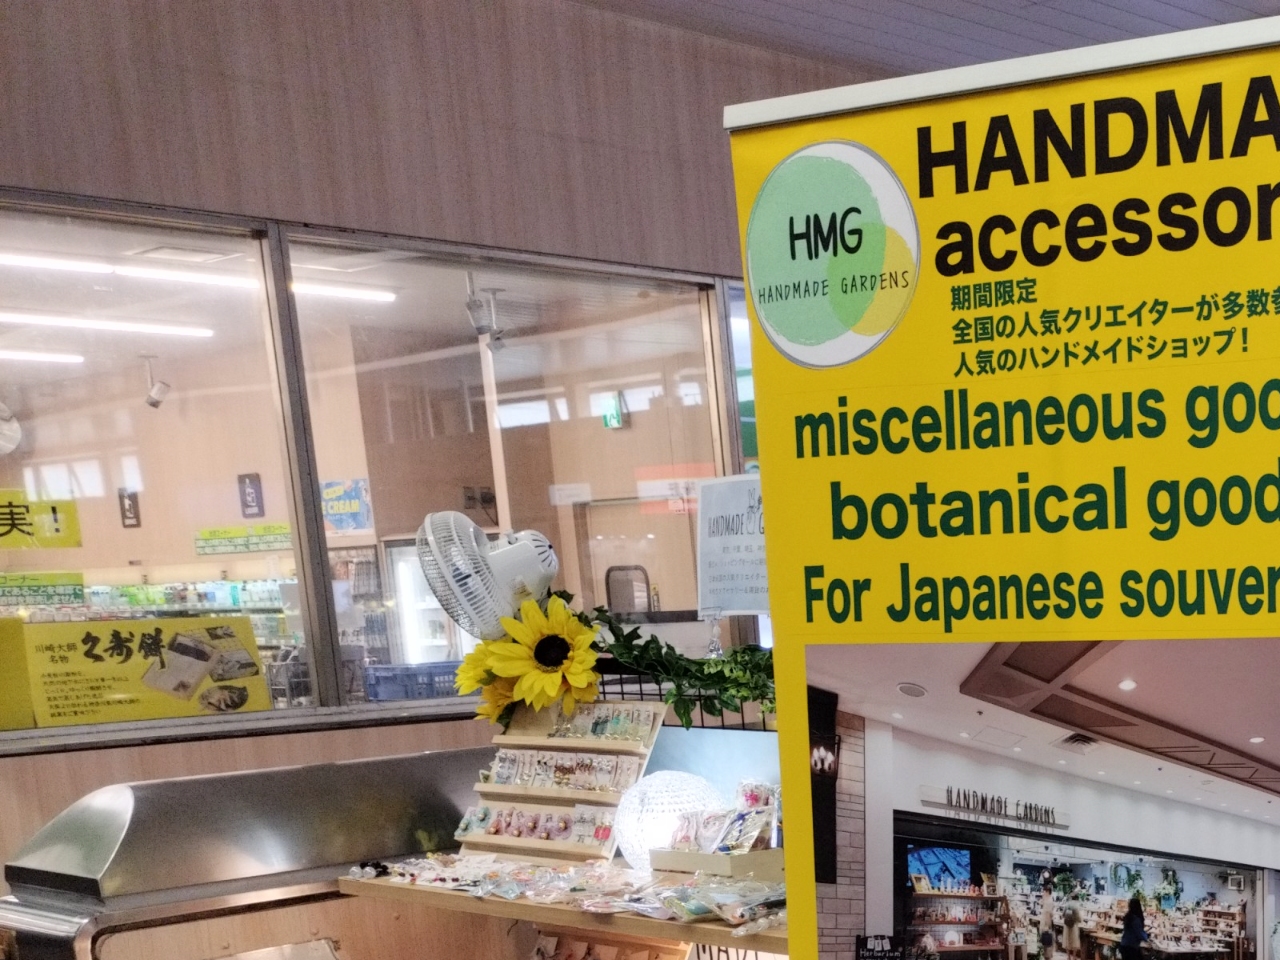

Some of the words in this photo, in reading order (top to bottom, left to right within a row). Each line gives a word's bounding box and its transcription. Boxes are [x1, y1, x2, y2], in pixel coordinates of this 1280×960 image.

[788, 206, 863, 261] HMG
[757, 278, 830, 305] HANDMADE
[840, 269, 911, 295] GARDENS
[950, 277, 1038, 312] 期間限定
[795, 388, 1168, 459] miscellaneous
[830, 466, 1127, 541] botanical
[708, 513, 745, 538] HANDMADE
[803, 565, 871, 624] For
[886, 562, 1104, 633] Japanese
[34, 642, 78, 654] 川崎大師
[946, 785, 1008, 818] HANDMADE
[1016, 800, 1056, 826] GARDENS
